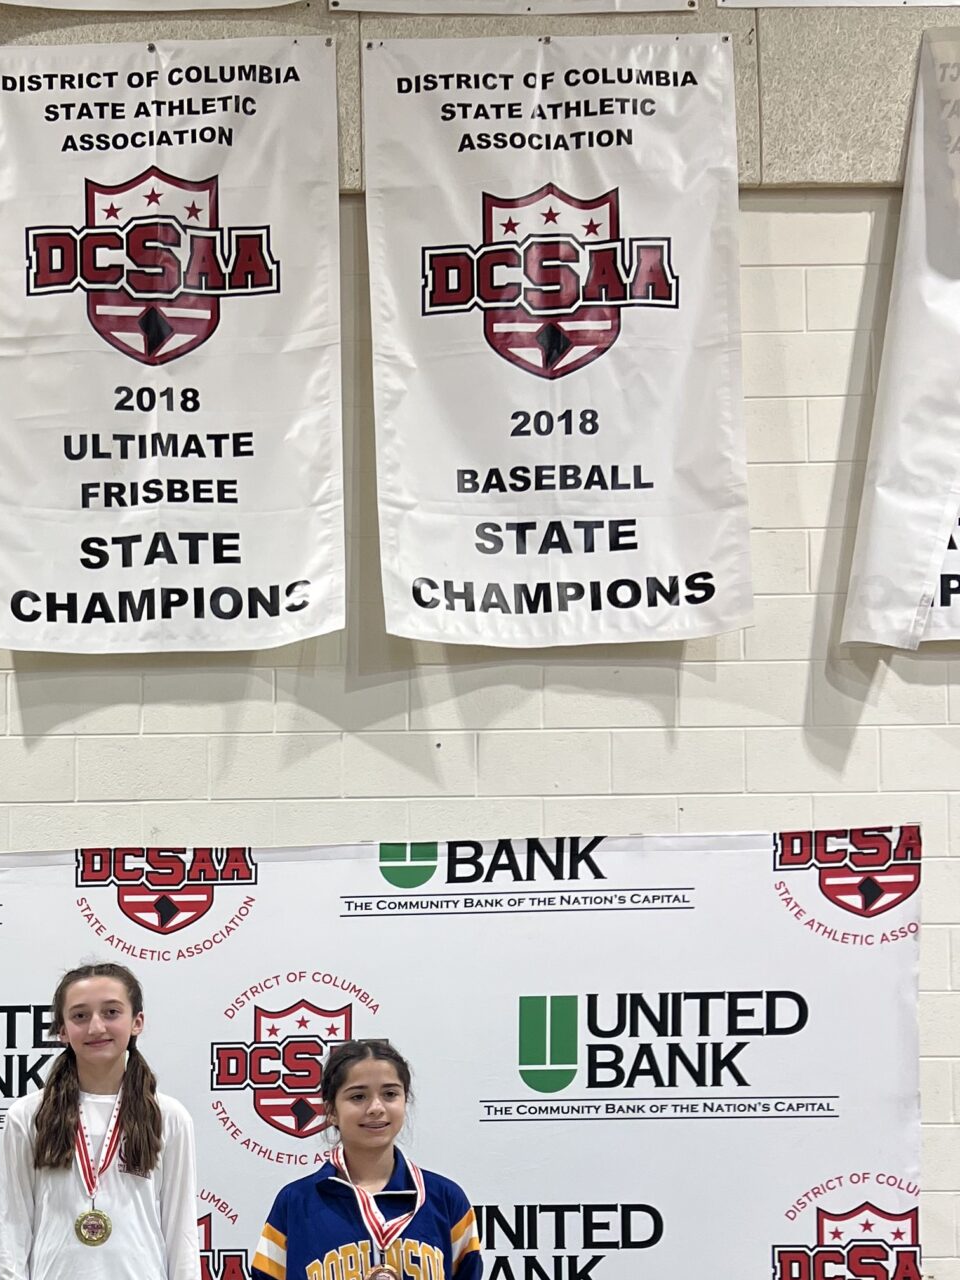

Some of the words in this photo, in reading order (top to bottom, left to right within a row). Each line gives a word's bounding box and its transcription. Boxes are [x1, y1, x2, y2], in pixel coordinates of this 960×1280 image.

[2, 72, 118, 92] DISTRICT
[127, 71, 159, 88] OF
[168, 65, 300, 85] COLUMBIA
[396, 73, 514, 94] DISTRICT
[522, 72, 555, 89] OF
[564, 68, 698, 88] COLUMBIA
[44, 100, 126, 122] STATE
[133, 96, 256, 119] ATHLETIC
[440, 102, 523, 122] STATE
[530, 97, 656, 119] ATHLETIC
[61, 127, 234, 152] ASSOCIATION
[457, 128, 634, 152] ASSOCIATION
[25, 214, 281, 298] DCSAA
[421, 233, 679, 316] DCSAA
[115, 387, 200, 412] 2018
[511, 410, 599, 436] 2018
[64, 432, 253, 460] ULTIMATE
[82, 479, 238, 508] FRISBEE
[457, 465, 653, 493] BASEBALL
[80, 532, 241, 569] STATE
[476, 519, 637, 554] STATE
[9, 580, 310, 624] CHAMPIONS
[411, 571, 716, 614] CHAMPIONS
[76, 848, 258, 890] DCSAA
[445, 836, 608, 884] BANK
[345, 901, 372, 910] THE
[377, 900, 459, 910] COMMUNITY
[464, 898, 502, 908] BANK
[508, 898, 525, 906] OF
[529, 898, 555, 906] THE
[560, 896, 626, 905] NATION'S
[630, 894, 690, 903] CAPITAL
[77, 897, 105, 935] STATE
[105, 934, 171, 962] ATHLETIC
[175, 896, 256, 961] ASSOCIATION
[224, 975, 281, 1020] DISTRICT
[286, 972, 307, 984] OF
[311, 971, 380, 1015] COLUMBIA
[586, 991, 808, 1038] UNITED
[586, 1042, 750, 1088] BANK
[484, 1106, 512, 1115] THE
[517, 1105, 601, 1114] COMMUNITY
[606, 1104, 645, 1113] BANK
[650, 1105, 668, 1113] OF
[671, 1104, 698, 1112] THE
[703, 1103, 770, 1112] NATION'S
[775, 1102, 834, 1111] CAPITAL
[211, 1100, 242, 1140] STATE
[241, 1138, 308, 1166] ATHLETIC
